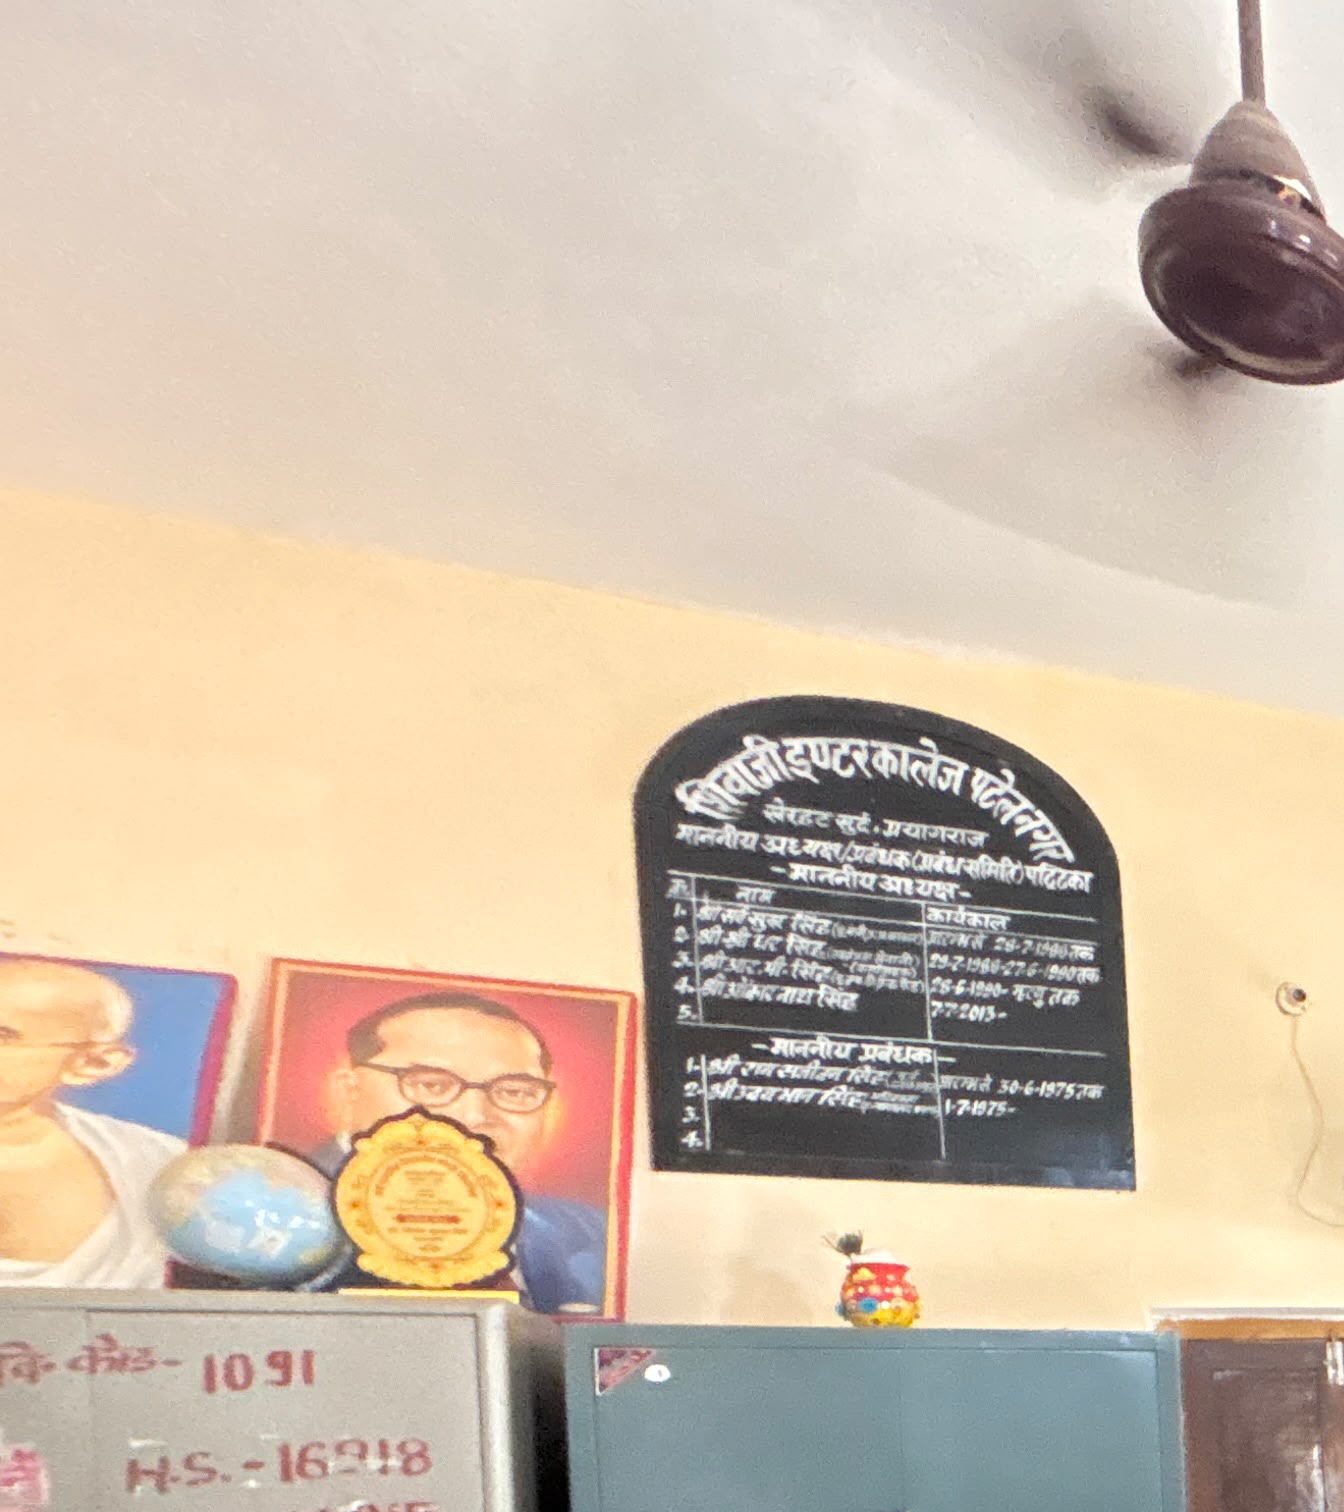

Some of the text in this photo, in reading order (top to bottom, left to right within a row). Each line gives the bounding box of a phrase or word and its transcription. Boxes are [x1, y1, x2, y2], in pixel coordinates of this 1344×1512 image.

[868, 737, 970, 796] कालेज
[971, 768, 1036, 825] पटेल
[675, 823, 760, 852] माननीय
[882, 818, 990, 848] प्रयागराज
[735, 884, 777, 905] नाम
[926, 905, 1012, 931] कार्यकाल
[1048, 988, 1081, 1007] तक
[201, 1349, 317, 1394] 1091
